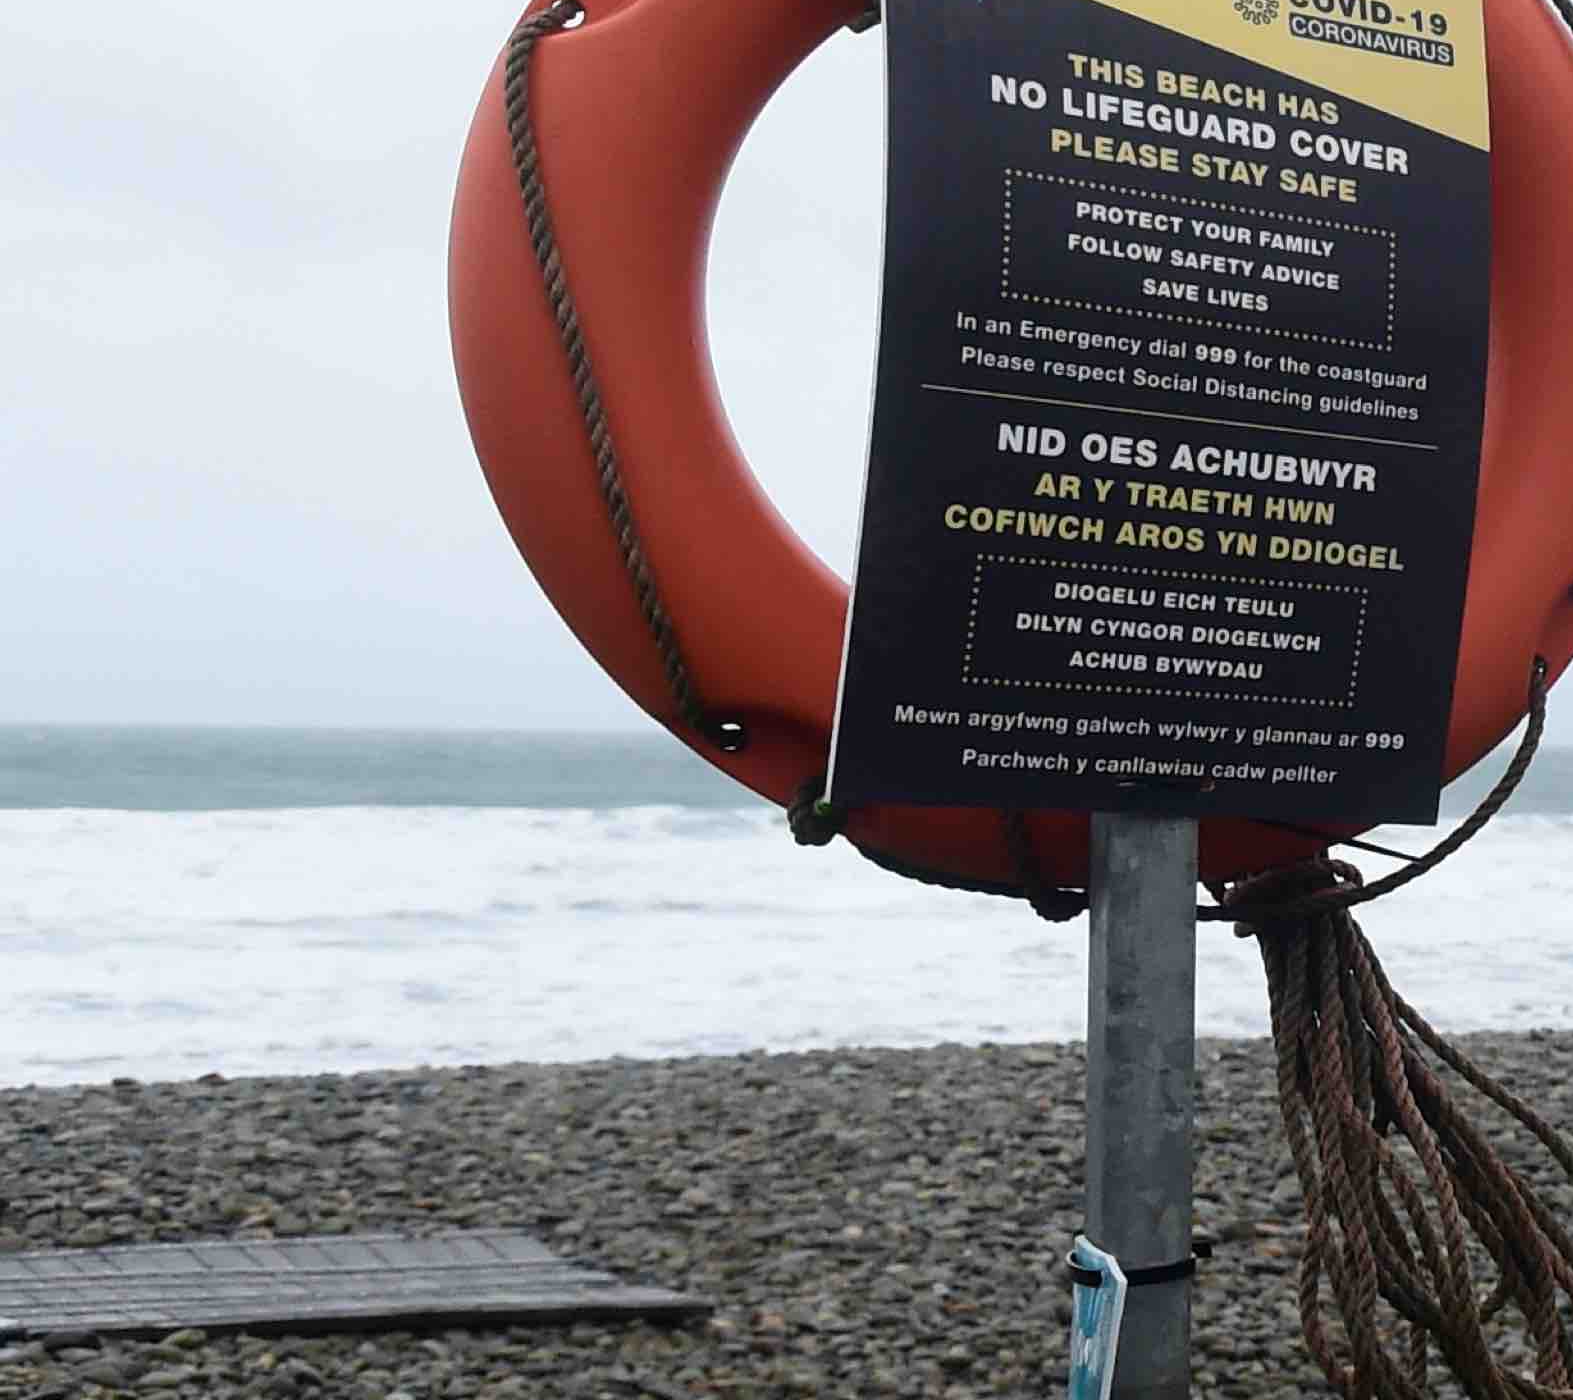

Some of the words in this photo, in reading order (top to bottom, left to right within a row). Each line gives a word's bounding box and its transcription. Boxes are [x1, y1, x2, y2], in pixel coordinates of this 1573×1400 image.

[1291, 16, 1450, 63] CORONAVIRUS
[1067, 52, 1145, 89] THIS
[1156, 69, 1266, 112] BEACH
[1277, 92, 1340, 125] HAS
[991, 74, 1048, 110] NO
[1062, 87, 1277, 150] LIFEGUARD
[1289, 129, 1409, 175] COVER
[1051, 128, 1180, 173] PLEASE
[1191, 152, 1270, 187] STAY
[1279, 168, 1357, 203] SAFE
[1076, 201, 1184, 234] PROTECT
[1191, 219, 1252, 245] YOUR
[1259, 230, 1335, 258] FAMILY
[1067, 233, 1163, 263] FOLLOW
[1170, 248, 1255, 277] SAFETY
[1260, 263, 1340, 291] ADVICE
[1142, 277, 1200, 302] SAVE
[1207, 287, 1269, 312] LIVES
[956, 311, 977, 331] In
[985, 319, 1012, 335] an
[1019, 319, 1142, 356] Emergency
[1148, 338, 1187, 359] dial
[1195, 343, 1237, 365] 999
[1244, 350, 1273, 370] for
[1279, 356, 1311, 375] the
[1317, 364, 1427, 391] coastguard
[961, 346, 1035, 372] Please
[1043, 361, 1125, 384] respect
[1132, 367, 1198, 393] Social
[1205, 377, 1313, 411] Distancing
[1319, 395, 1419, 421] guidelines
[997, 422, 1066, 457] NID
[1081, 433, 1158, 468] OES
[1169, 443, 1377, 492] ACHUBWYR
[1034, 472, 1081, 500] AR
[1094, 478, 1115, 502] Y
[1126, 481, 1253, 517] TRAETH
[1264, 496, 1335, 526] HWN
[944, 504, 1104, 542] COFIWCH
[1115, 521, 1204, 552] AROS
[1217, 530, 1258, 557] YN
[1269, 535, 1404, 571] DDIOGEL
[1054, 582, 1156, 606] DIOGELU
[1163, 591, 1217, 611] EICH
[1224, 596, 1294, 618] TEULU
[1016, 612, 1083, 634] DILYN
[1090, 618, 1184, 642] CYNGOR
[1191, 626, 1321, 652] DIOGELWCH
[1069, 650, 1148, 671] ACHUB
[1155, 656, 1263, 679] BYWYDAU
[894, 704, 960, 725] Mewn
[967, 711, 1068, 735] argyfwng
[1076, 716, 1151, 736] galwch
[1158, 721, 1229, 742] wylwyr
[1235, 727, 1246, 744] y
[1252, 726, 1332, 746] glannau
[1338, 734, 1359, 747] ar
[1365, 732, 1405, 750] 999
[962, 748, 1069, 770] Parchwch
[1076, 758, 1088, 775] y
[1095, 756, 1205, 777] canllawiau
[1211, 762, 1266, 779] cadw
[1271, 765, 1337, 784] pellter
